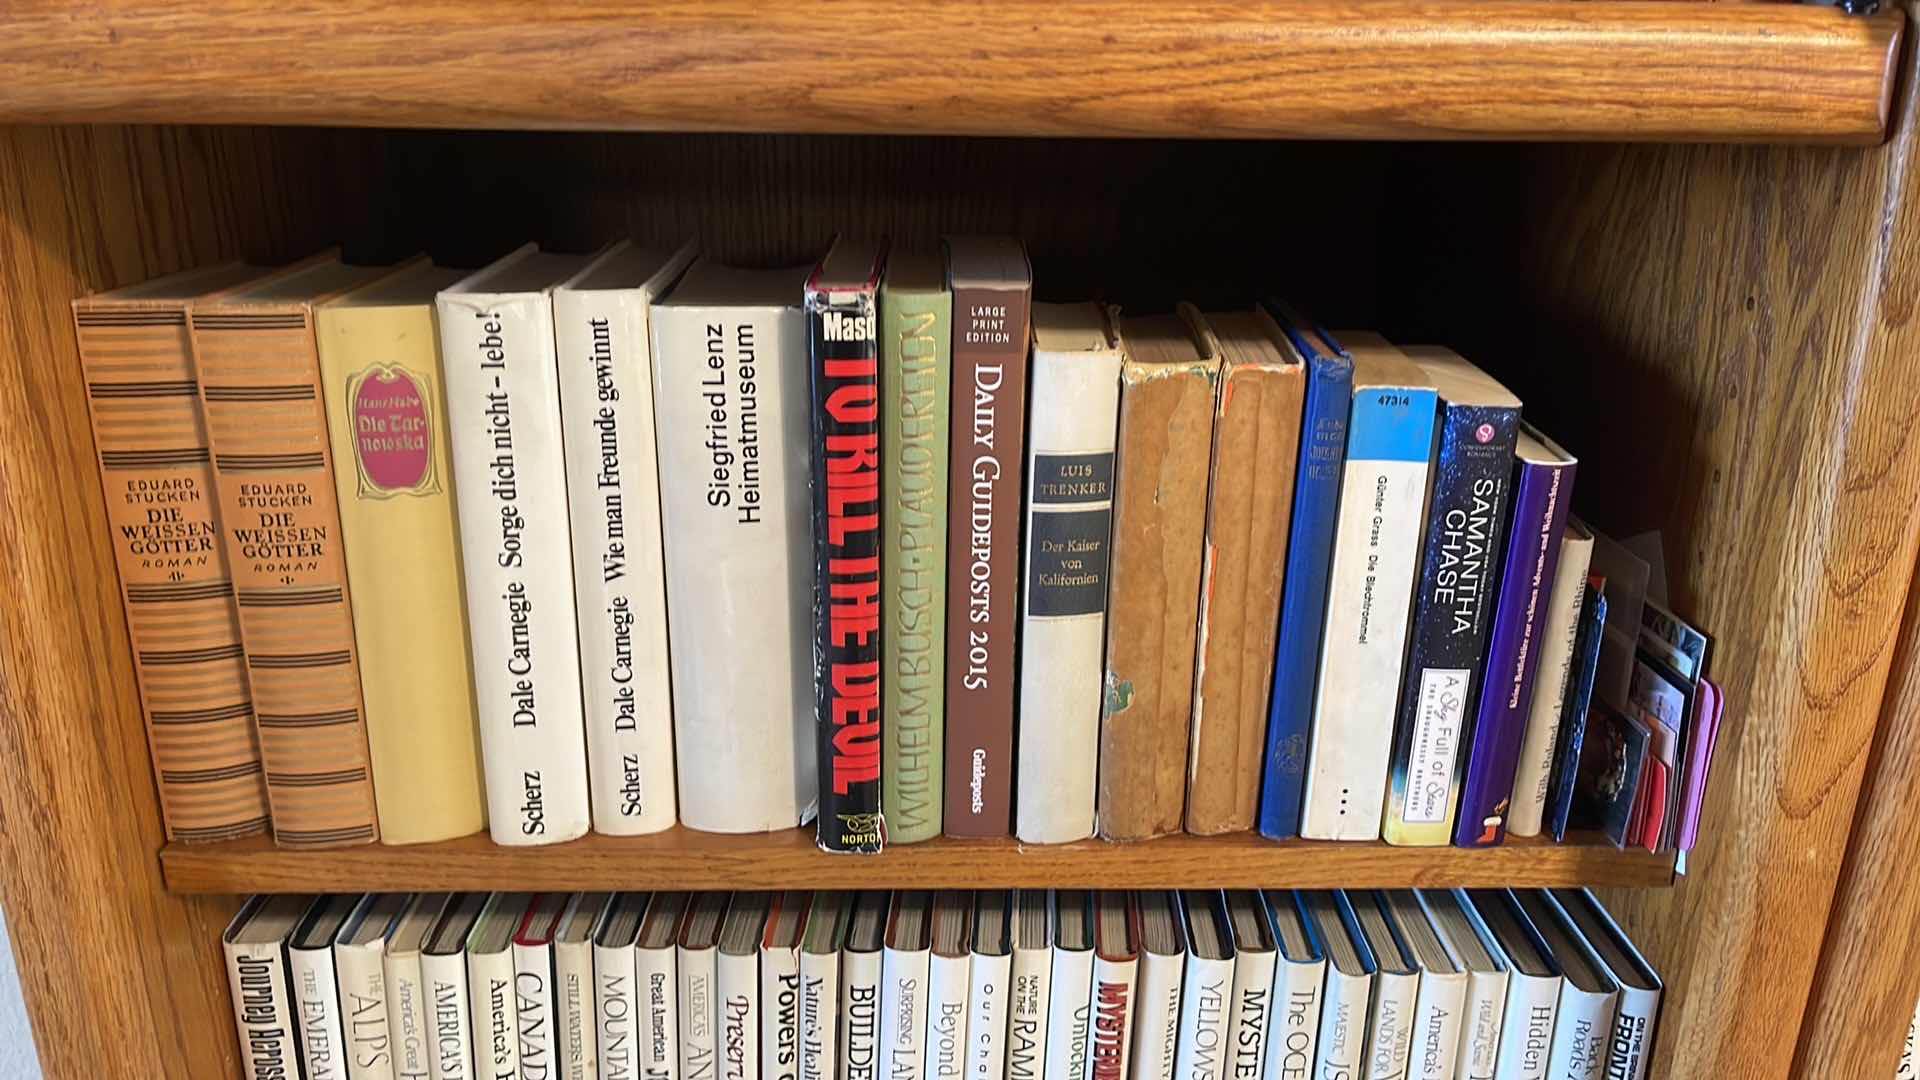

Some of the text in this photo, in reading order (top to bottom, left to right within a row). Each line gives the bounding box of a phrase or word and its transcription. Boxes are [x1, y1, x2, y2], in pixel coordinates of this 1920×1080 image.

[971, 306, 1006, 317] LARGE
[972, 319, 1004, 330] PRINT
[476, 311, 506, 370] lebe!
[966, 332, 1010, 343] EDITION
[485, 392, 512, 449] nicht
[702, 322, 734, 507] Siegfried Lenz
[1377, 395, 1409, 407] 47314
[359, 415, 386, 433] Die
[736, 324, 761, 524] Heimatmuseum
[588, 317, 627, 583] Wie man Freunde gewinnt
[1060, 464, 1093, 477] LUIS
[125, 490, 200, 504] STUCKEN
[127, 478, 194, 491] EDUARD
[241, 483, 307, 496] EDUARD
[490, 459, 517, 500] dich
[1040, 482, 1106, 496] TRENKER
[147, 508, 184, 524] DIE
[238, 495, 312, 508] STUCKEN
[260, 512, 296, 528] DIE
[121, 521, 216, 540] WEISSEN
[130, 536, 214, 555] GÖTTER
[234, 526, 327, 544] WEISSEN
[499, 504, 525, 567] Sorge
[963, 363, 1003, 690] DAILY GUIDEPOSTS 2015
[1041, 539, 1100, 553] Der Kaiser
[142, 556, 208, 568] ROMAN
[242, 542, 324, 559] GÖTTER
[254, 561, 318, 573] ROMAN
[1061, 559, 1082, 570] von
[1358, 474, 1388, 645] Günter Grass Die Blechtrommel
[1434, 509, 1467, 605] CHASE
[1451, 478, 1494, 635] SAMANTHA
[1039, 573, 1099, 587] Kalifornien
[897, 567, 932, 678] BUSCH
[501, 582, 537, 728] Dale Carnegie
[607, 596, 637, 732] Dale Carnegie
[896, 687, 932, 832] WILHELM
[1425, 676, 1459, 818] A Sky Full of Stars
[620, 753, 642, 817] Scherz
[971, 748, 986, 815] Guideposts
[521, 770, 545, 835] Scherz
[236, 955, 276, 1024] Journey
[304, 971, 317, 996] THE
[651, 973, 665, 1005] Great
[982, 983, 993, 1021] Our
[1016, 975, 1027, 1014] ON THE
[1028, 975, 1039, 1015] NATURE
[350, 972, 389, 1069] THE ALPS
[434, 981, 463, 1072] AMERICA'S
[490, 979, 511, 1064] America's
[778, 973, 798, 1065] Powers
[805, 976, 823, 1037] Nature's
[1288, 986, 1316, 1026] The
[1377, 1000, 1398, 1046] LANDS
[652, 1007, 667, 1062] American
[933, 1002, 962, 1076] Beyond
[1163, 987, 1178, 1078] THE MIGHTY
[1394, 1027, 1408, 1062] WILD
[1424, 1005, 1448, 1073] America's
[1524, 1007, 1550, 1070] Hidden
[1569, 1019, 1592, 1070] Roads
[1374, 1048, 1393, 1073] FOR
[1585, 1036, 1603, 1075] Back
